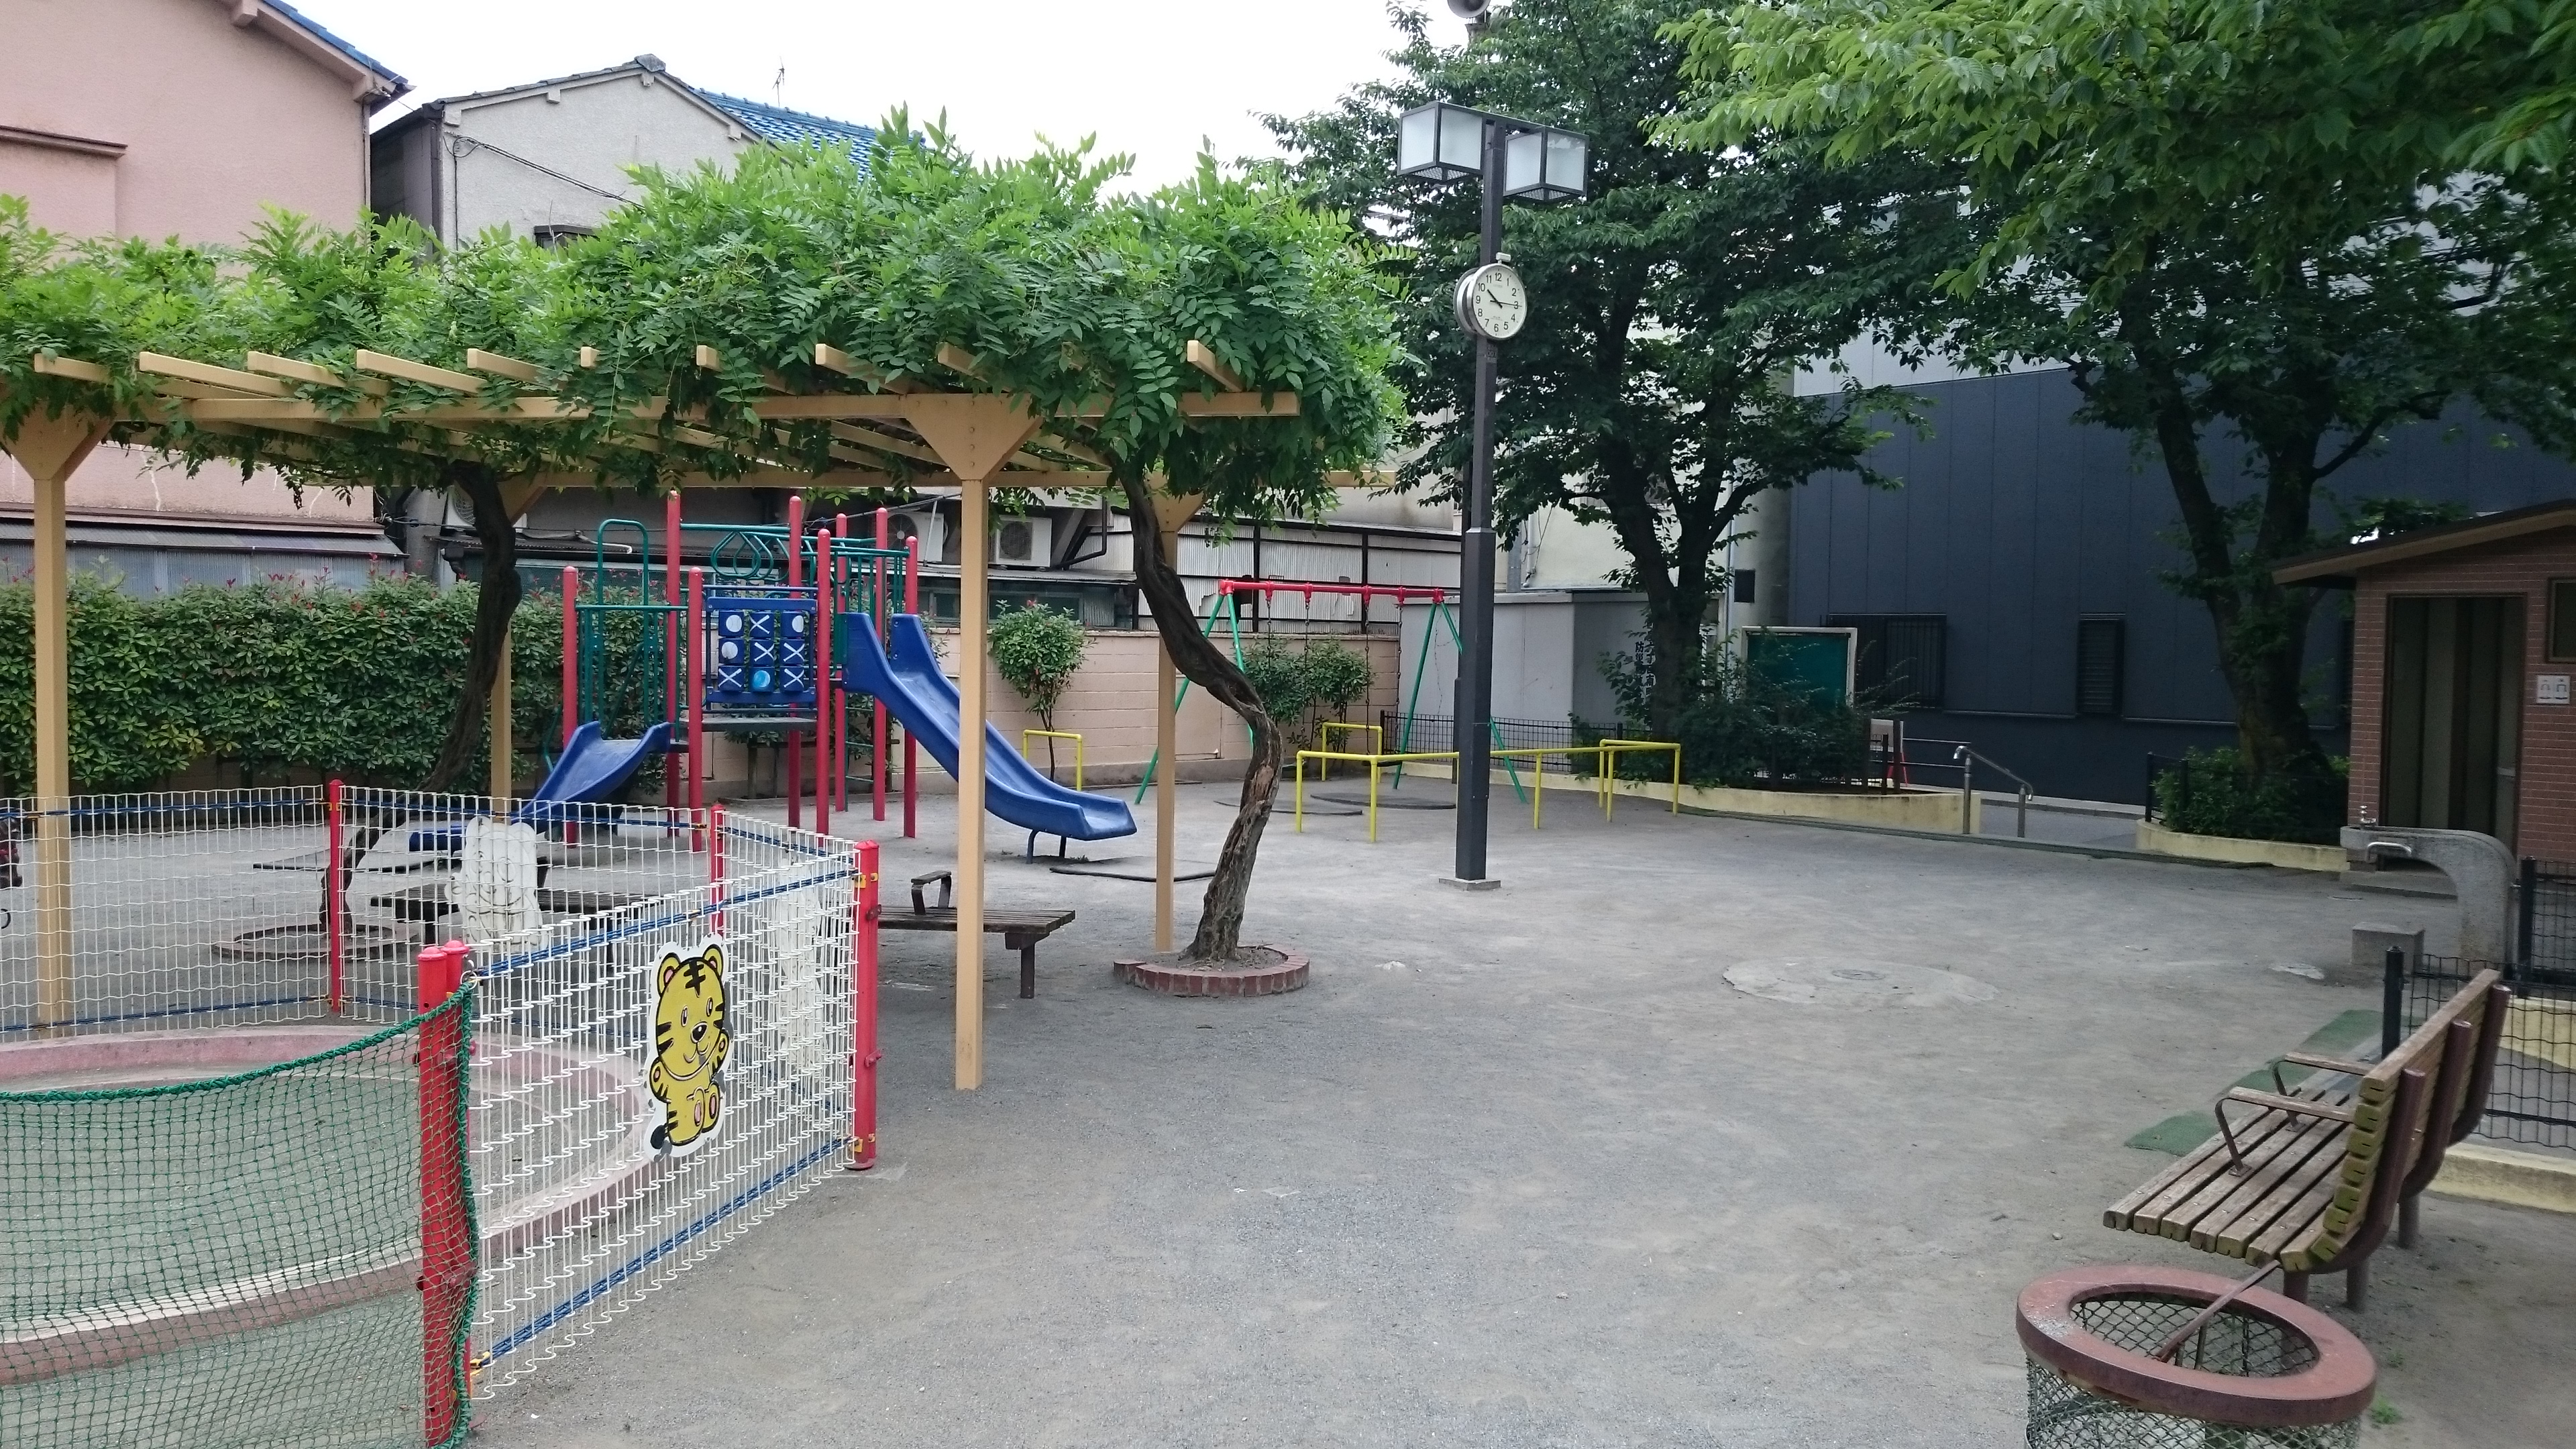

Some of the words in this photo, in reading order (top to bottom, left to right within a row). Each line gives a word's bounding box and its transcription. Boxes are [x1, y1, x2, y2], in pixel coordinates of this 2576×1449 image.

[1486, 275, 1492, 283] 11
[1495, 272, 1502, 281] 12
[1479, 283, 1485, 292] 10
[1512, 288, 1516, 297] 2
[1476, 295, 1481, 304] 9
[1514, 301, 1519, 309] 3
[1478, 309, 1483, 317] 8
[1511, 314, 1515, 322] 4
[1485, 319, 1489, 327] 7
[1504, 322, 1508, 330] 5
[1494, 323, 1499, 332] 6
